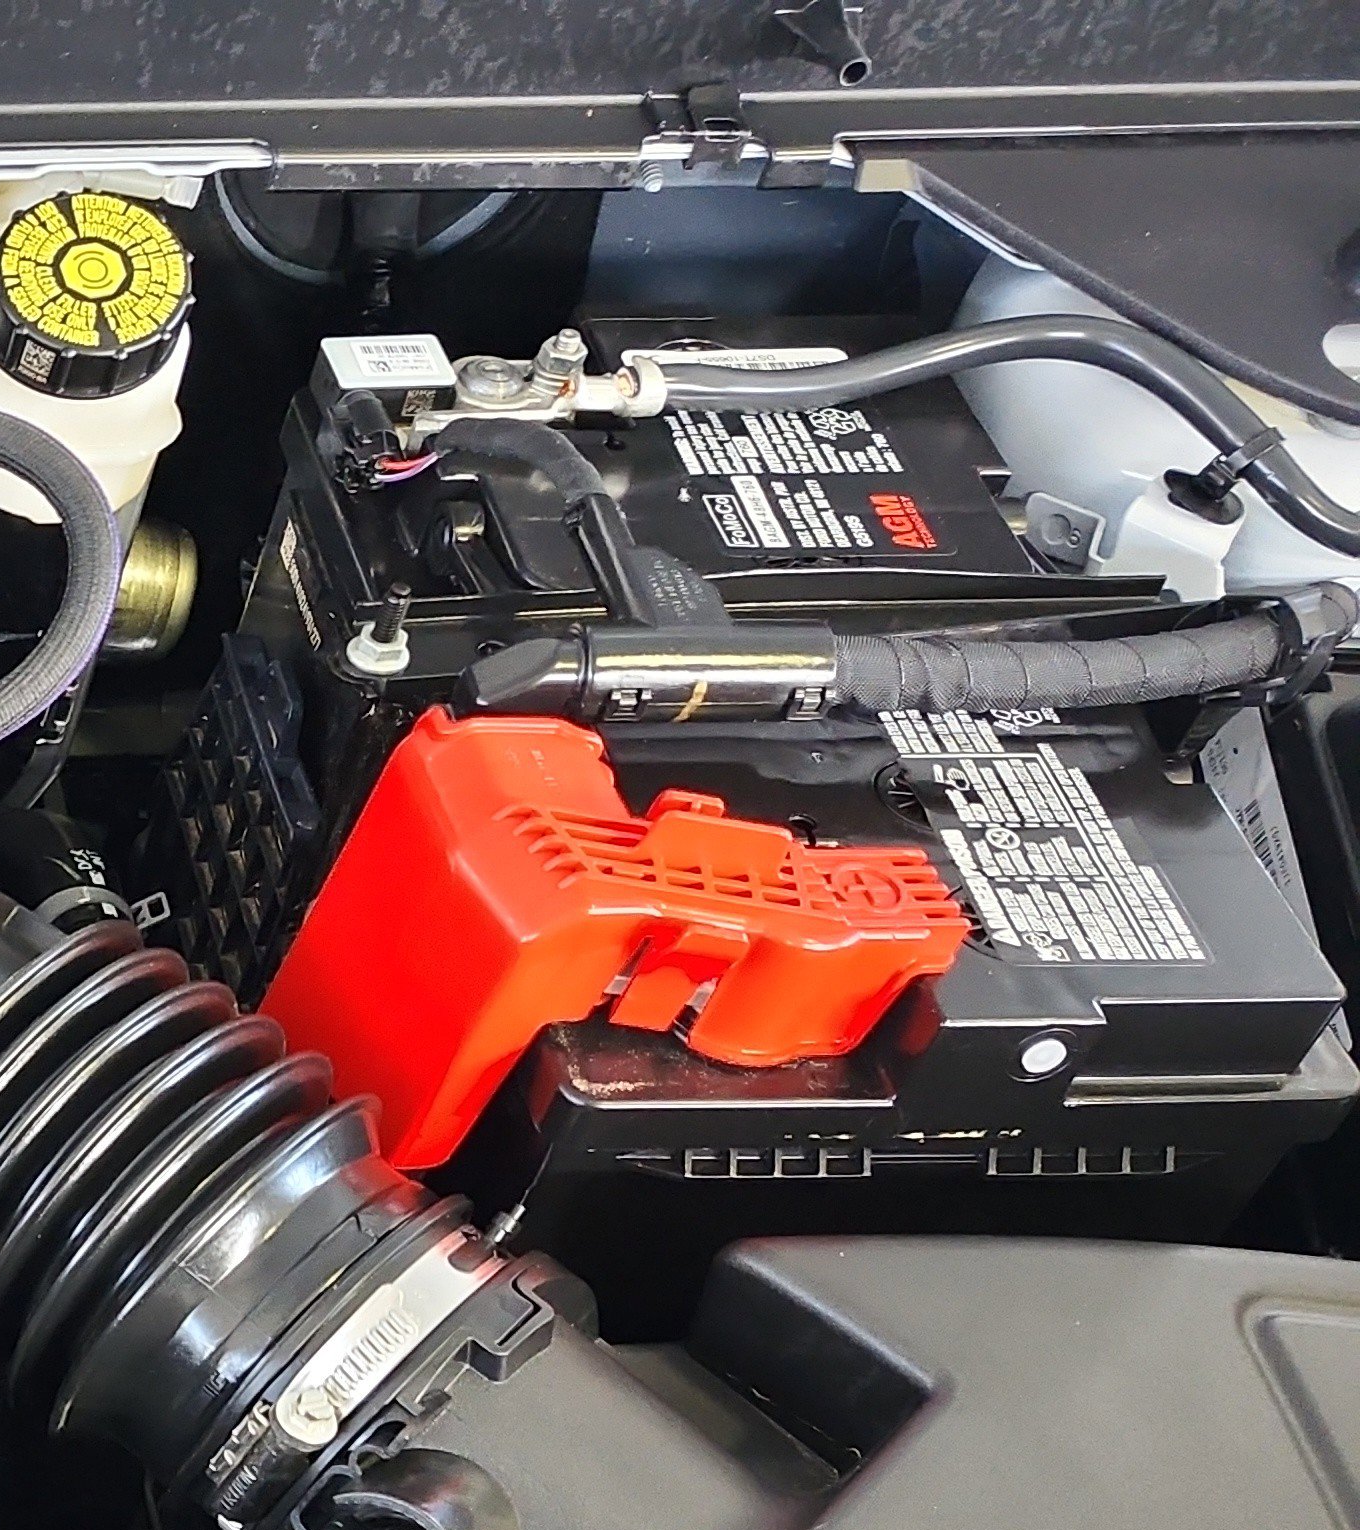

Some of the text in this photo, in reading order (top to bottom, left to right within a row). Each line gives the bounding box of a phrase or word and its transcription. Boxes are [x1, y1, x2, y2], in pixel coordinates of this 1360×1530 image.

[713, 496, 749, 544] FoMoCo
[872, 496, 923, 547] AGM
[900, 497, 936, 547] TECHNOLOGY
